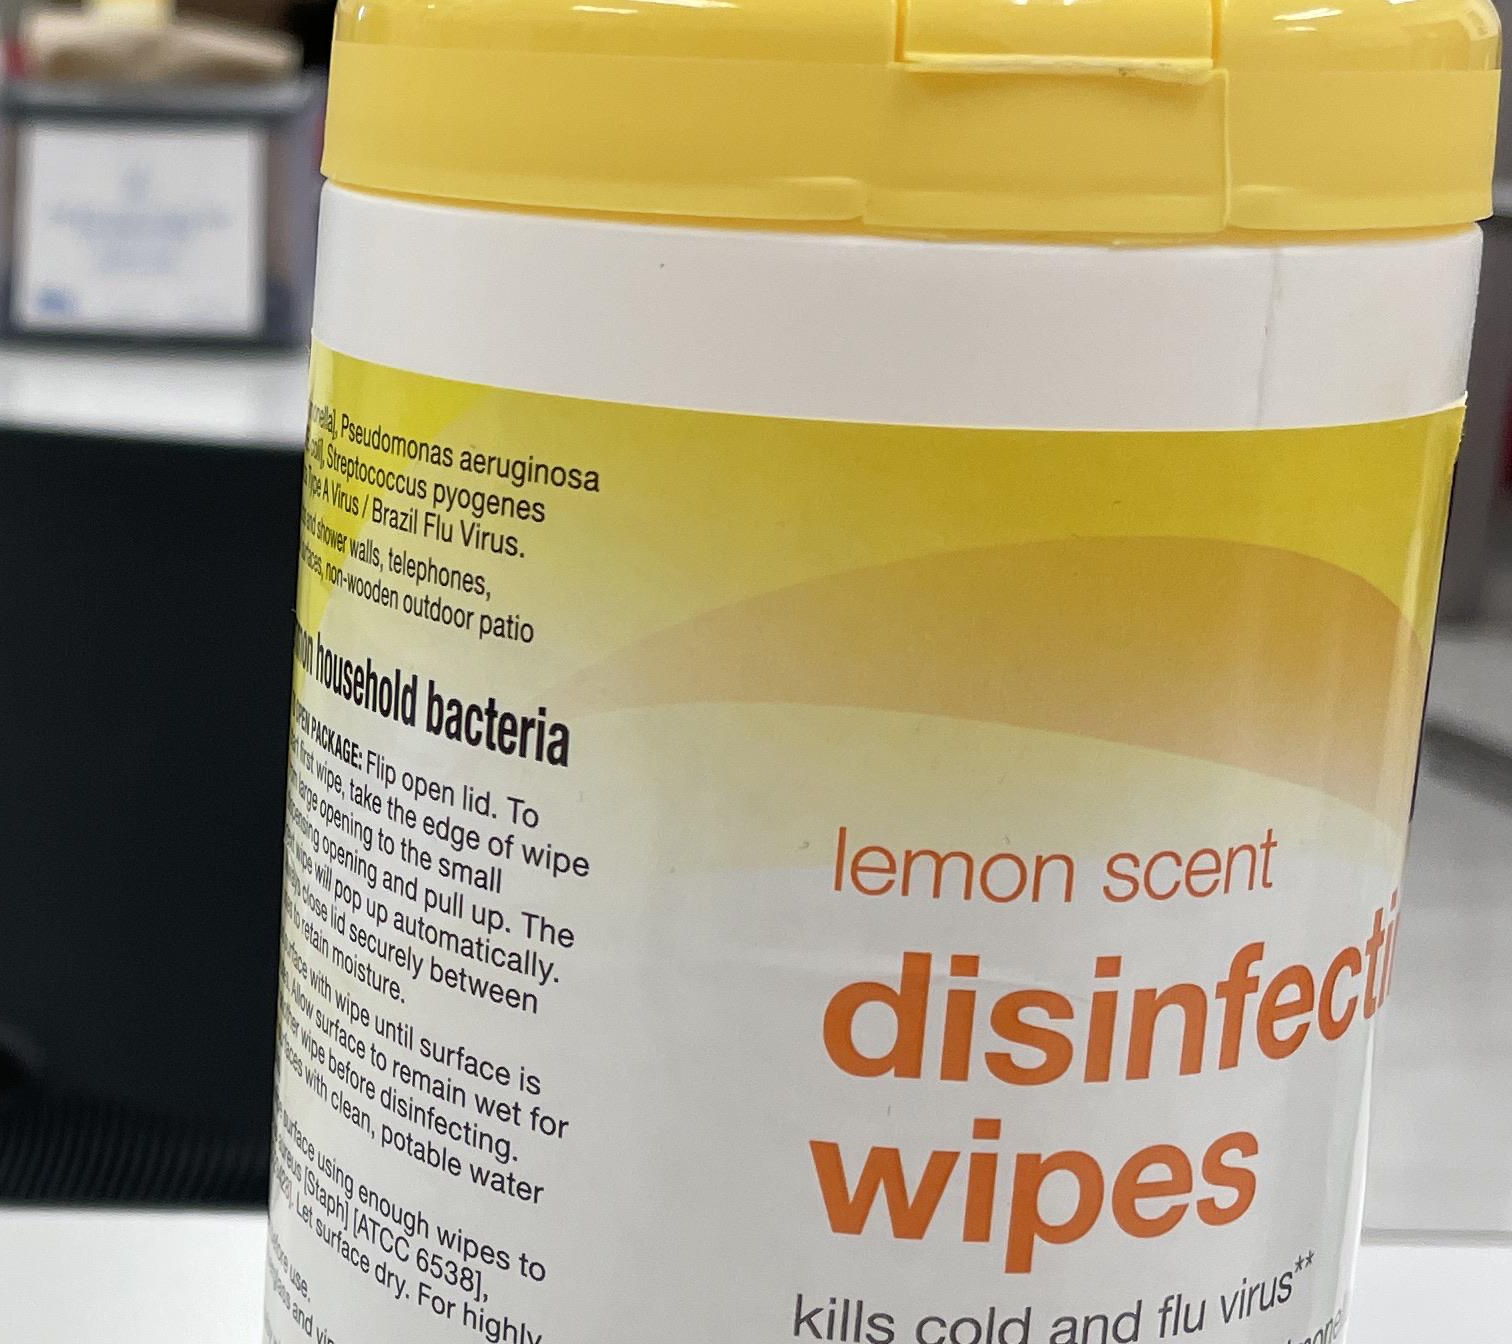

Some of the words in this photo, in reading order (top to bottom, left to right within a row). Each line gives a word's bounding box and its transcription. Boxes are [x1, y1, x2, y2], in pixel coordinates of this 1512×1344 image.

[327, 444, 427, 499] Streptococcus
[434, 479, 545, 522] pyogenes
[341, 414, 453, 467] Pseudomonas
[460, 448, 600, 492] aeruginosa
[323, 477, 329, 502] A
[332, 481, 359, 517] Virus
[362, 494, 369, 518] /
[372, 497, 418, 533] Brazil
[424, 512, 453, 543] Flu
[460, 520, 525, 557] Virus.
[326, 560, 399, 610] non-wooden
[403, 591, 474, 629] outdoor
[479, 612, 534, 644] patio
[350, 538, 383, 572] walls,
[388, 547, 491, 601] telephones,
[316, 632, 417, 727] household
[426, 680, 570, 768] bacteria
[311, 716, 362, 770] PACKAGE:
[366, 751, 396, 788] Flip
[402, 772, 454, 806] open
[463, 785, 497, 818] lid.
[507, 796, 539, 828] To
[320, 800, 372, 851] opening
[378, 828, 394, 855] to
[401, 838, 432, 870] the
[439, 857, 502, 893] small
[350, 779, 381, 814] take
[388, 796, 416, 828] the
[424, 815, 479, 850] edge
[488, 834, 514, 857] of
[522, 842, 589, 877] wipe
[833, 826, 1076, 904] lemon
[1103, 828, 1278, 903] scent
[315, 862, 332, 891] will
[335, 878, 361, 909] pop
[367, 900, 388, 924] up
[394, 912, 559, 985] automatically.
[323, 838, 377, 888] opening
[383, 870, 417, 901] and
[425, 887, 463, 918] pull
[472, 903, 510, 933] up.
[522, 912, 575, 948] The
[331, 904, 345, 935] lid
[349, 926, 423, 978] securely
[430, 956, 538, 1013] between
[333, 945, 405, 1004] moisture.
[316, 1009, 365, 1058] surface
[371, 1044, 386, 1070] to
[393, 1060, 466, 1107] remain
[474, 1092, 521, 1127] wet
[530, 1107, 569, 1139] for
[335, 990, 369, 1027] wipe
[375, 1015, 413, 1051] until
[420, 1038, 510, 1086] surface
[519, 1067, 541, 1095] is
[329, 1048, 375, 1099] before
[380, 1087, 518, 1165] disinfecting.
[331, 1090, 374, 1139] clean,
[381, 1124, 461, 1177] potable
[470, 1161, 544, 1204] water
[318, 1151, 353, 1200] using
[359, 1185, 429, 1239] enough
[437, 1226, 510, 1270] wipes
[519, 1255, 545, 1282] to
[809, 1117, 1259, 1276] wipes
[297, 1192, 312, 1228] Let
[316, 1218, 369, 1273] surface
[375, 1261, 410, 1300] dry.
[418, 1282, 455, 1319] For
[353, 1207, 409, 1263] [ATCC
[416, 1248, 488, 1302] 6538],
[293, 1302, 313, 1337] and
[1158, 1294, 1206, 1338] flu
